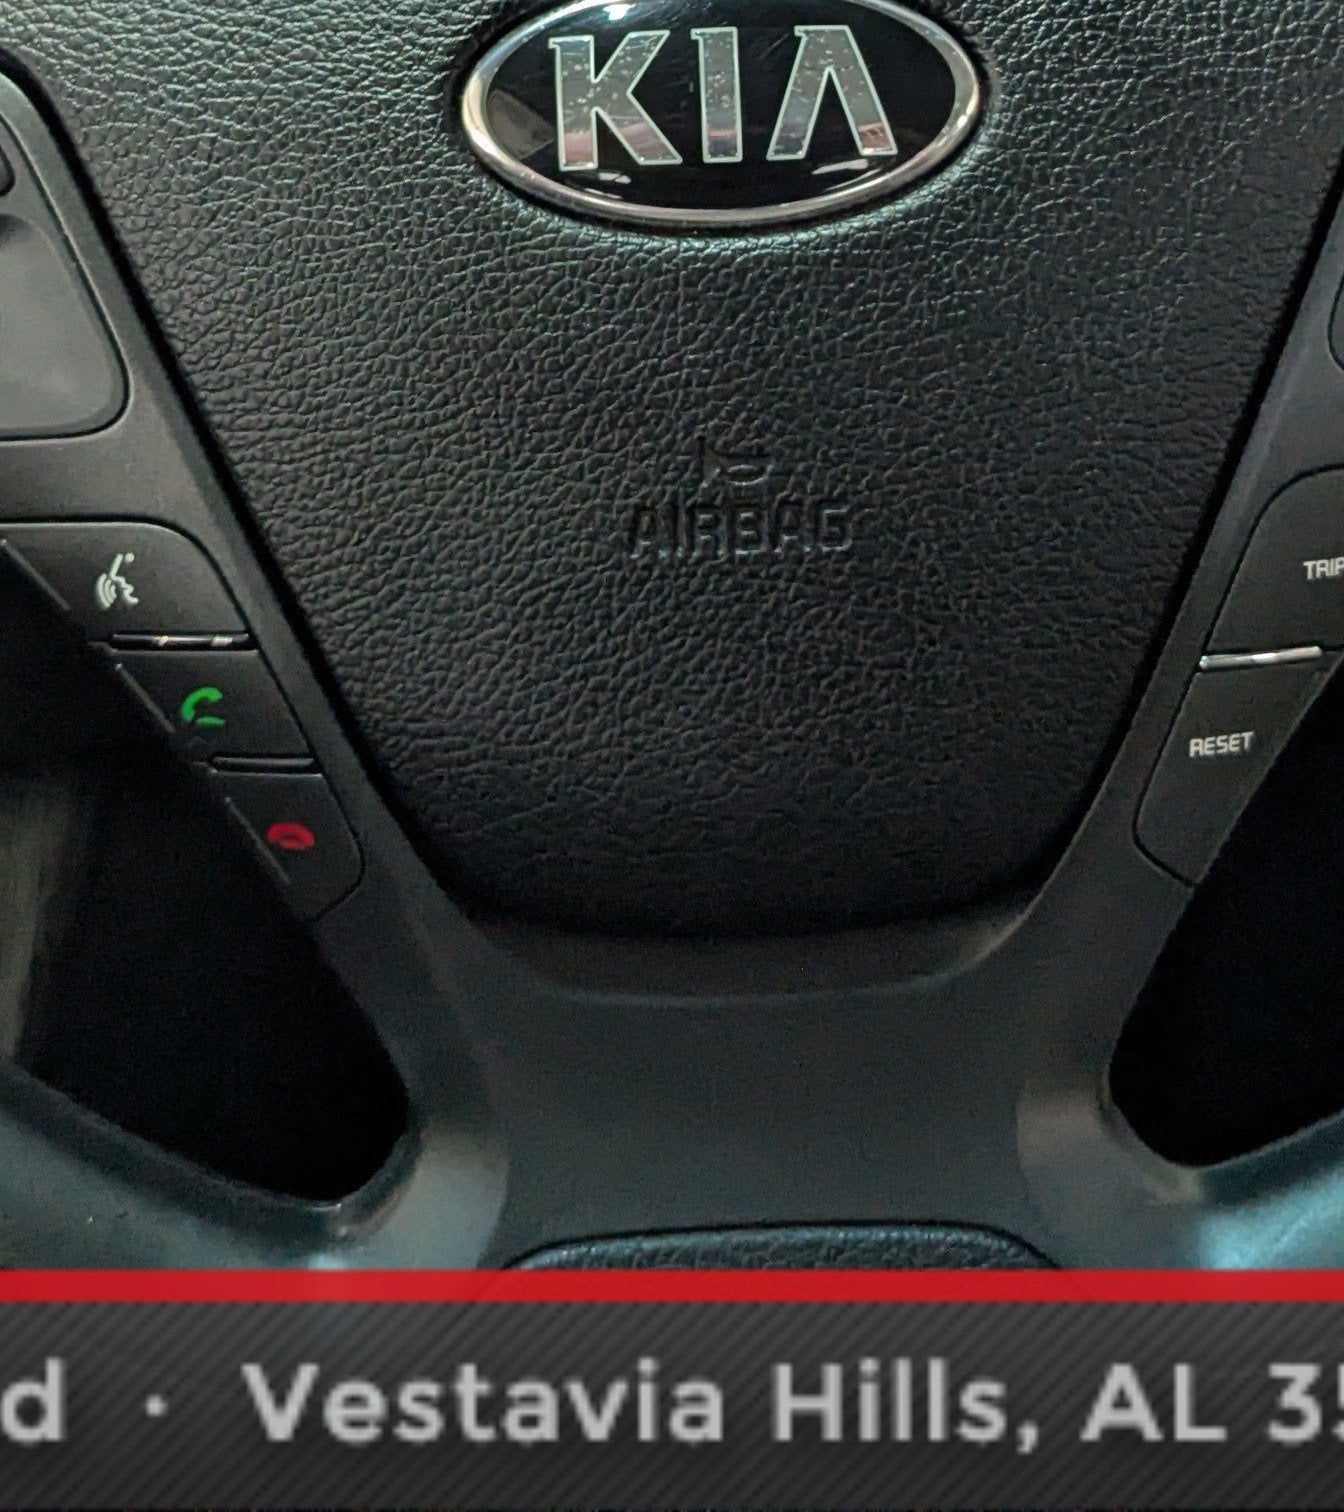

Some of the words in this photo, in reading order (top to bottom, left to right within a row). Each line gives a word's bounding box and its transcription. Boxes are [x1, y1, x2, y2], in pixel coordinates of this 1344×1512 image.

[548, 23, 899, 172] KIA
[629, 503, 854, 560] AIRBAG
[1189, 732, 1254, 758] RESET
